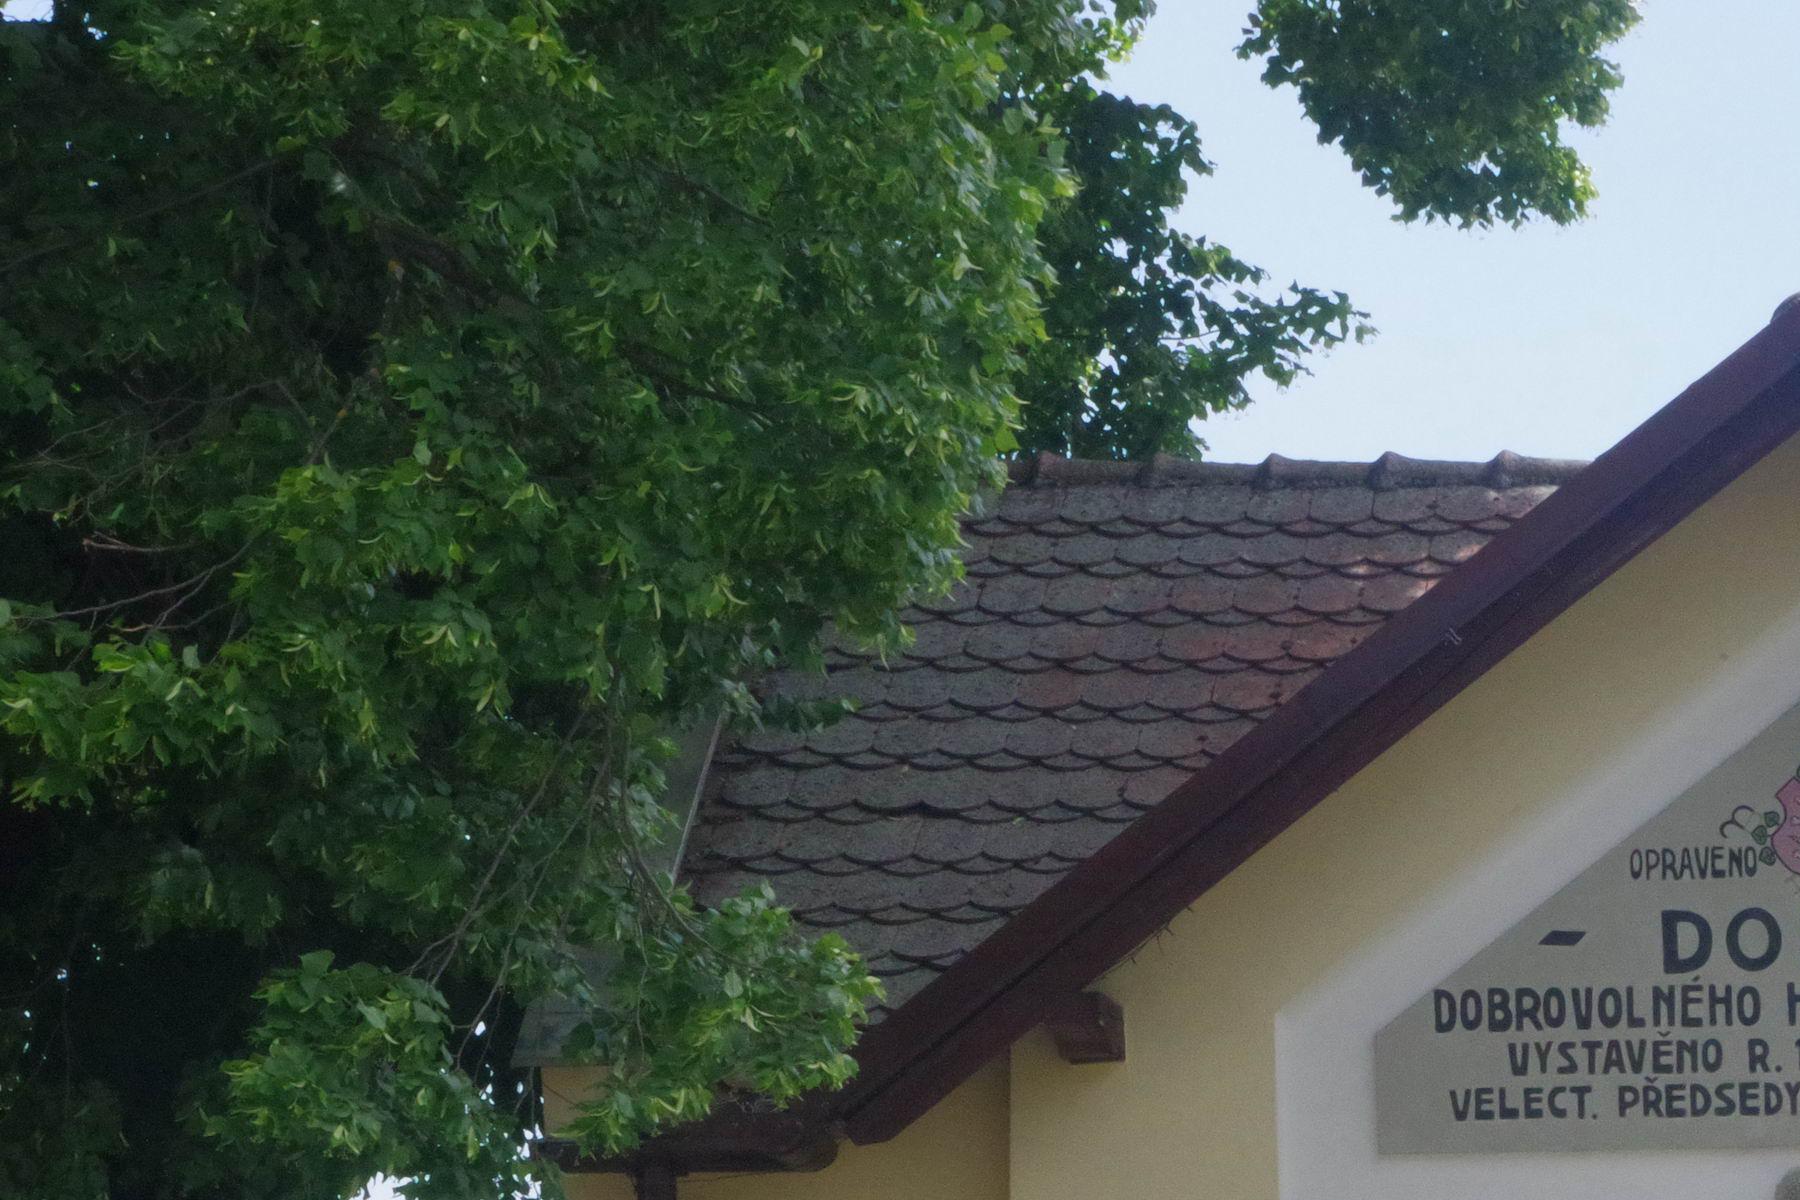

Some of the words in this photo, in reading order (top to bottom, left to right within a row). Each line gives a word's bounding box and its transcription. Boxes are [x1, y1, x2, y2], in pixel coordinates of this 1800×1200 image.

[1629, 846, 1758, 882] OPRAVENO
[1433, 975, 1763, 1034] DOBROVOLNÉHO
[1507, 1030, 1724, 1077] VYSTAVĚNO
[1449, 1085, 1600, 1123] VELECT.
